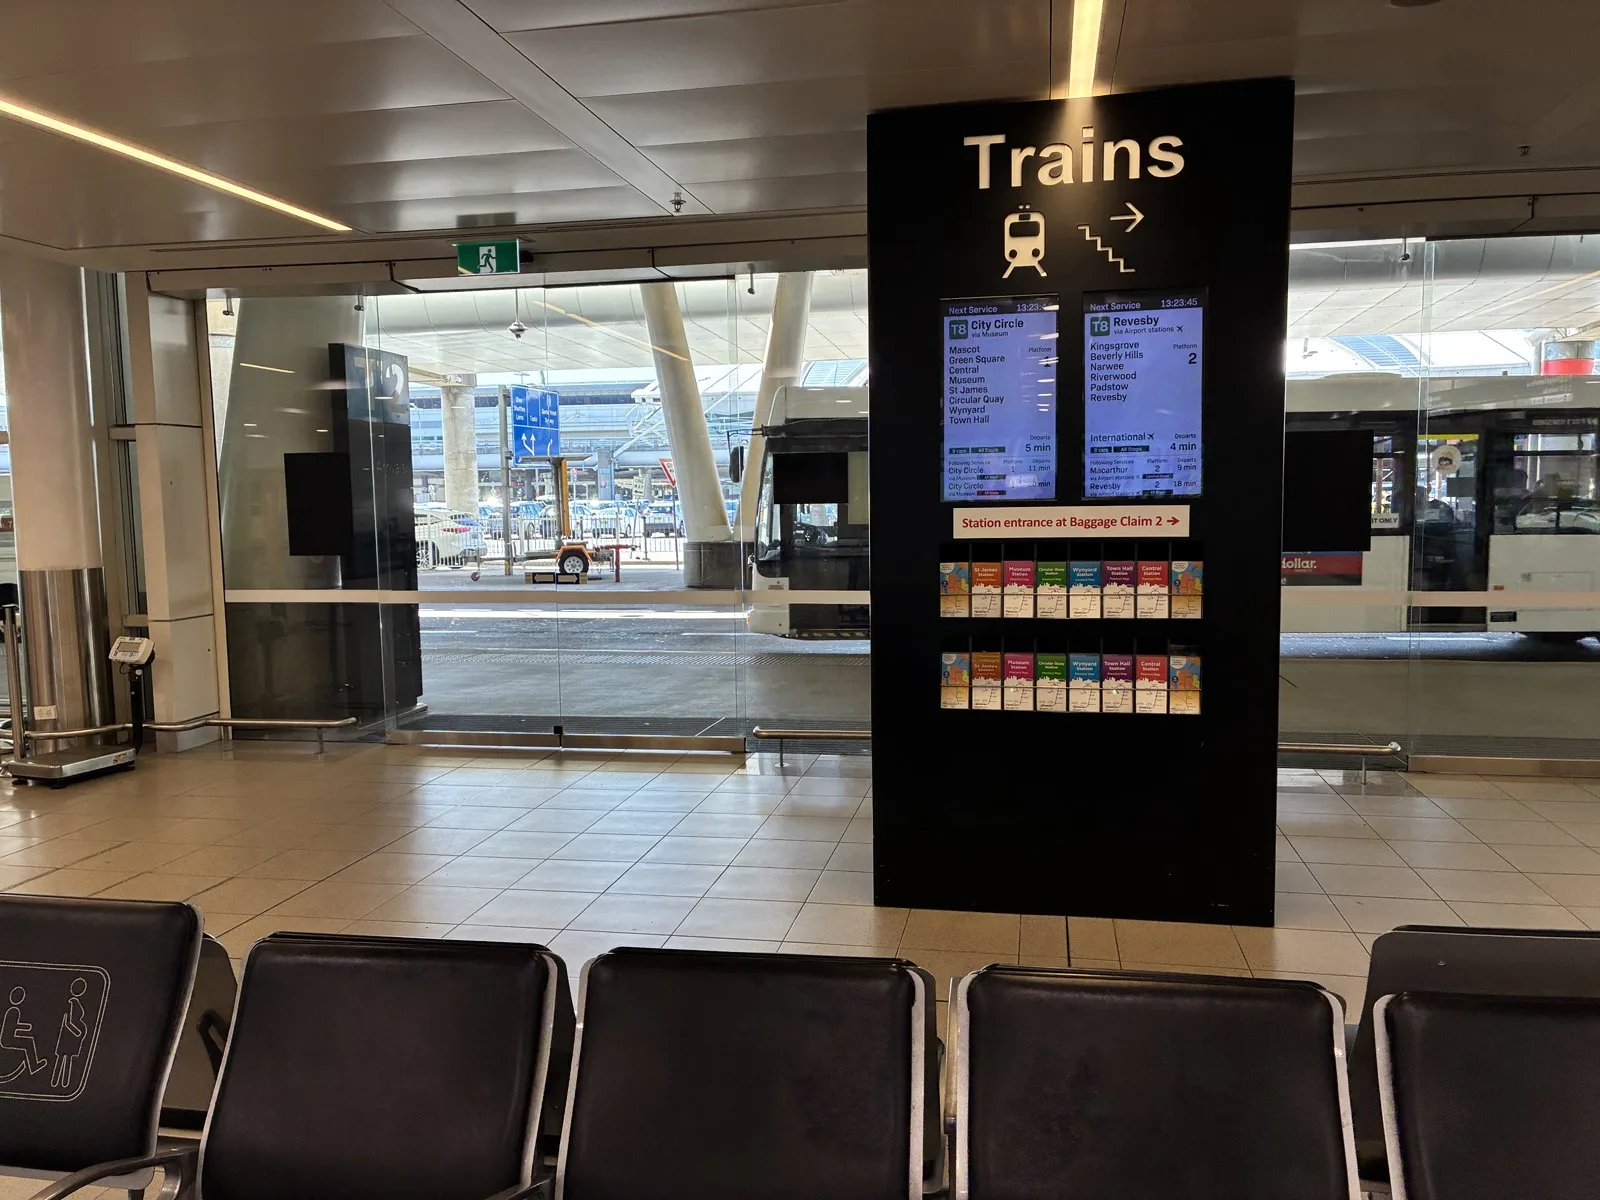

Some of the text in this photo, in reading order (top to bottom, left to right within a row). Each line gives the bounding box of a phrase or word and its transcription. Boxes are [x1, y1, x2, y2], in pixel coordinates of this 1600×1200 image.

[963, 125, 1185, 189] Trains
[1017, 303, 1051, 312] 13:23:
[1111, 302, 1141, 310] Service
[1161, 298, 1197, 308] 13:23:45
[968, 306, 997, 314] Service
[951, 318, 1023, 335] T8 City Circle
[1092, 316, 1159, 332] T8 Revesby
[949, 346, 980, 354] Mascot
[1090, 342, 1139, 351] Kingsgrove
[975, 355, 1005, 364] Square
[1090, 350, 1144, 361] Beverly Hills
[1188, 352, 1197, 364] 2
[949, 366, 979, 374] Central
[1090, 371, 1136, 381] Riverwood
[1090, 383, 1128, 391] Padstow
[983, 395, 1004, 404] Quay
[1090, 393, 1127, 402] Revesby
[949, 406, 985, 415] Wynyard
[1090, 433, 1146, 442] International
[1026, 443, 1051, 452] 5 min
[1179, 442, 1196, 450] min
[962, 516, 1162, 529] Station entrance at Baggage Claim 2
